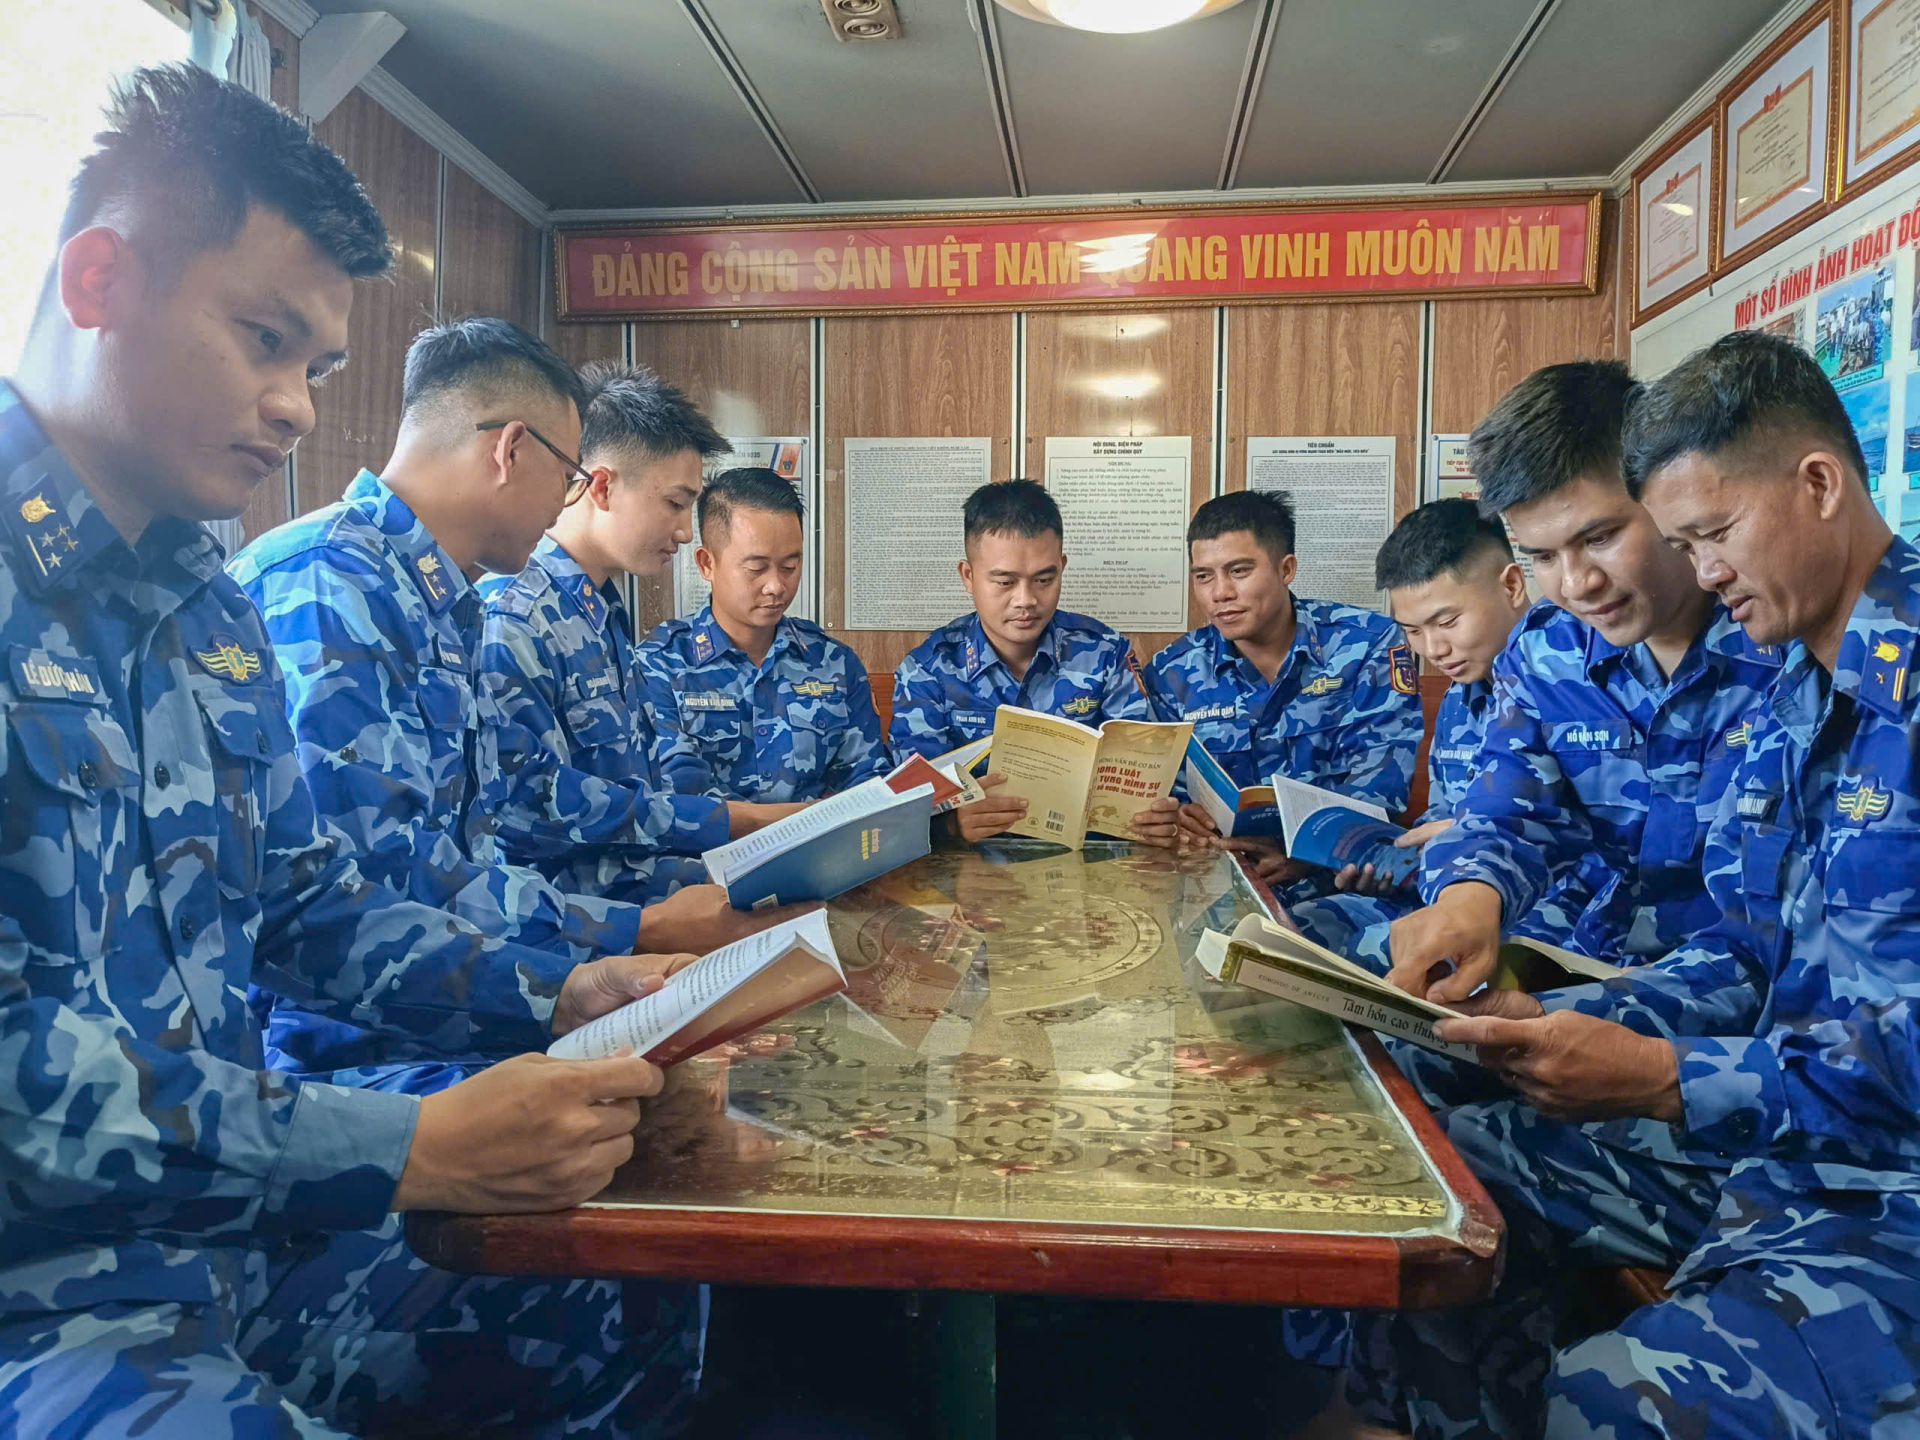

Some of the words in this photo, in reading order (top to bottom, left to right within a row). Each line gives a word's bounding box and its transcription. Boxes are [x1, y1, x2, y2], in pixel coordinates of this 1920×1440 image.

[592, 241, 689, 297] ĐẢNG
[703, 241, 798, 301] CỘNG
[814, 235, 891, 291] SẢN
[903, 236, 982, 296] VIỆT
[996, 240, 1080, 286] NAM
[1241, 231, 1329, 279] VINH
[1346, 219, 1461, 276] MUÔN
[1475, 216, 1560, 273] NĂM
[1760, 270, 1780, 318] SỐ
[1780, 266, 1813, 307] HÌNH
[1815, 245, 1849, 291] ẢNH
[1851, 218, 1895, 268] HOẠT
[1099, 775, 1122, 785] TỤNG
[1123, 777, 1146, 790] HÌNH
[1148, 781, 1161, 791] SỰ
[1119, 767, 1141, 779] LUẬT
[1342, 997, 1364, 1016] Tâm
[1391, 1016, 1409, 1030] cao
